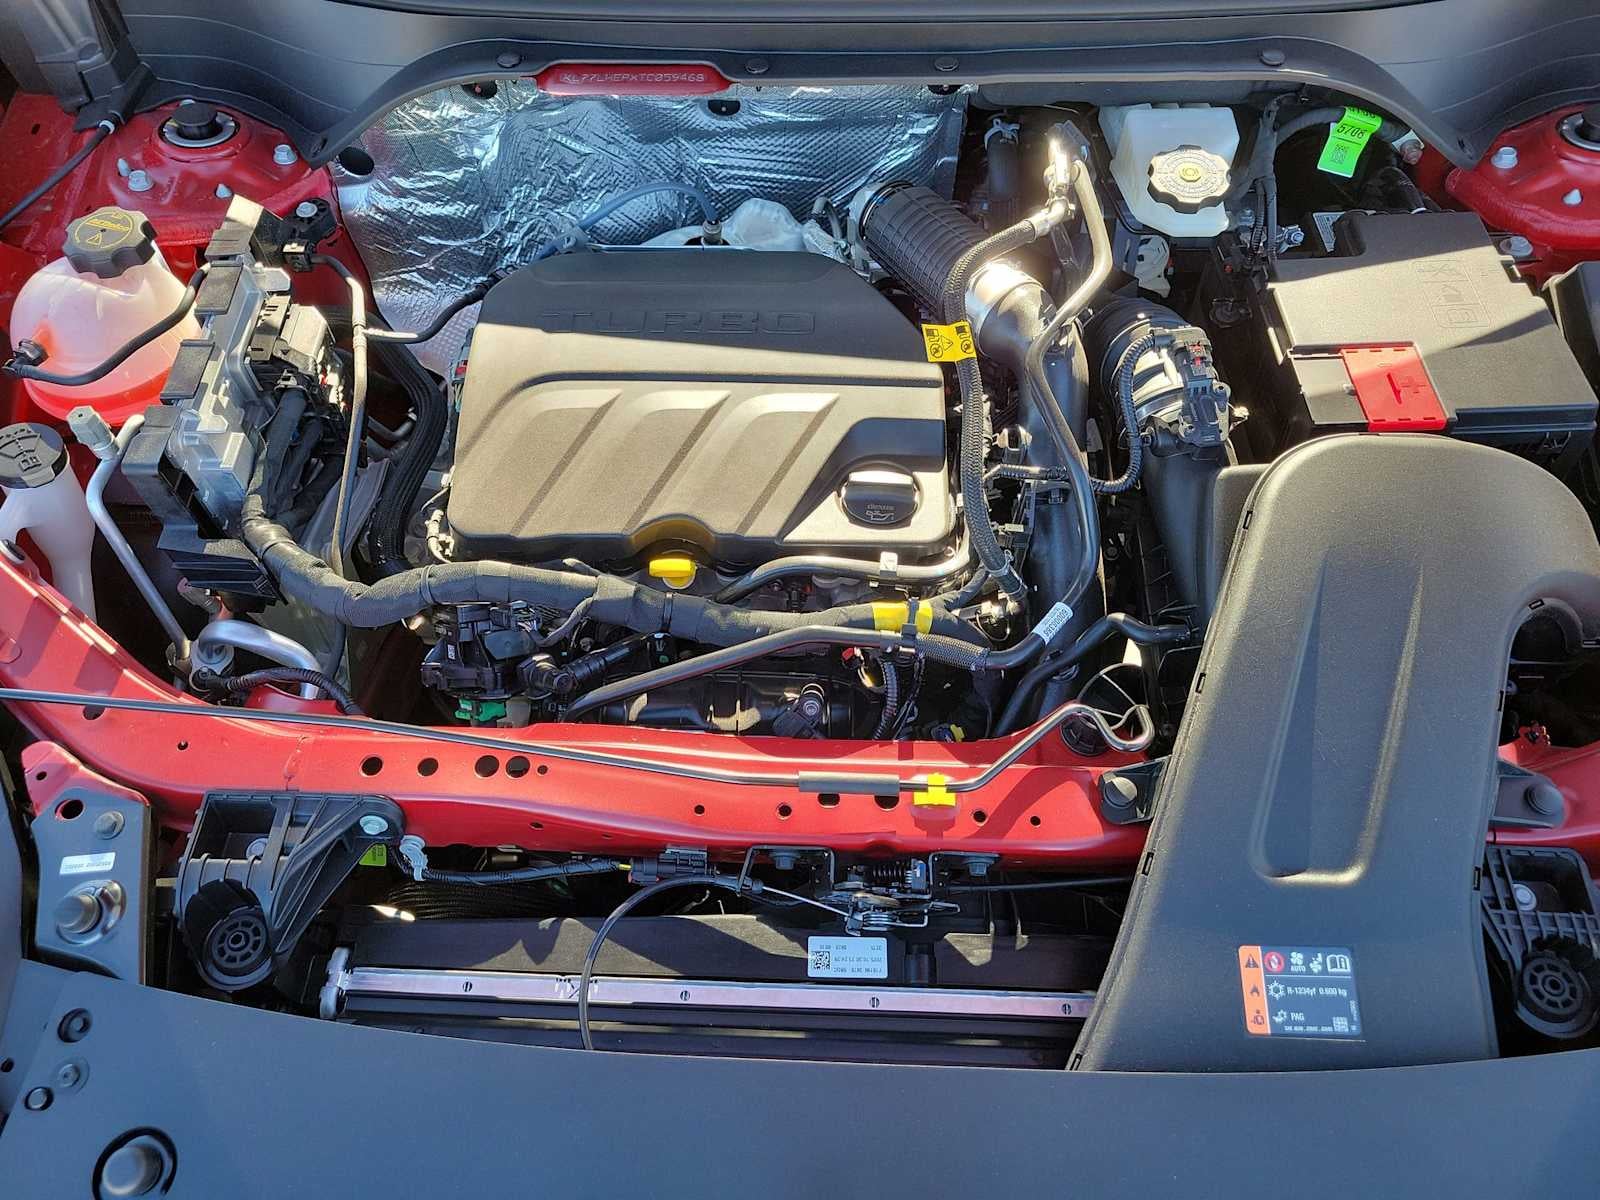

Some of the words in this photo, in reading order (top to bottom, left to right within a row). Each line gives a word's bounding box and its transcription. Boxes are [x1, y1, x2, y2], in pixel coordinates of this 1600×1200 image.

[541, 310, 816, 335] TURBO
[1337, 987, 1348, 997] kg
[1290, 1012, 1305, 1021] PAG
